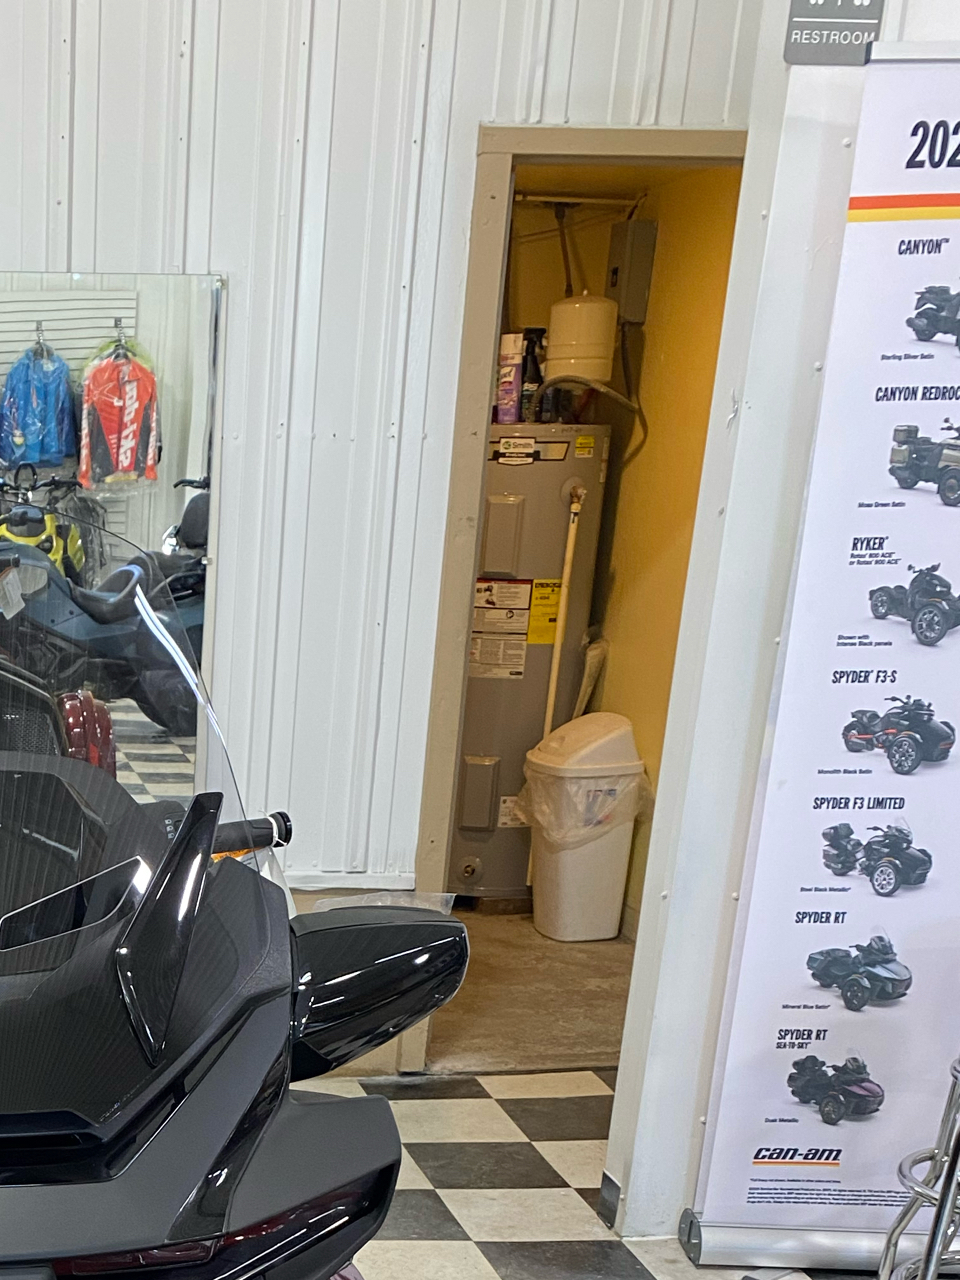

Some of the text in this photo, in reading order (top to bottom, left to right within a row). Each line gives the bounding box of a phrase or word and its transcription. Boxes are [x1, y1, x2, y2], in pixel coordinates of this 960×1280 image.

[791, 30, 876, 45] RESTROOM
[875, 386, 920, 402] CANYON
[875, 670, 897, 683] F3-S
[812, 796, 905, 810] SPYDER F3 LIMITED
[795, 911, 847, 924] SPYDER RT
[777, 1029, 828, 1041] SPYDER RT
[753, 1147, 843, 1162] can-am
